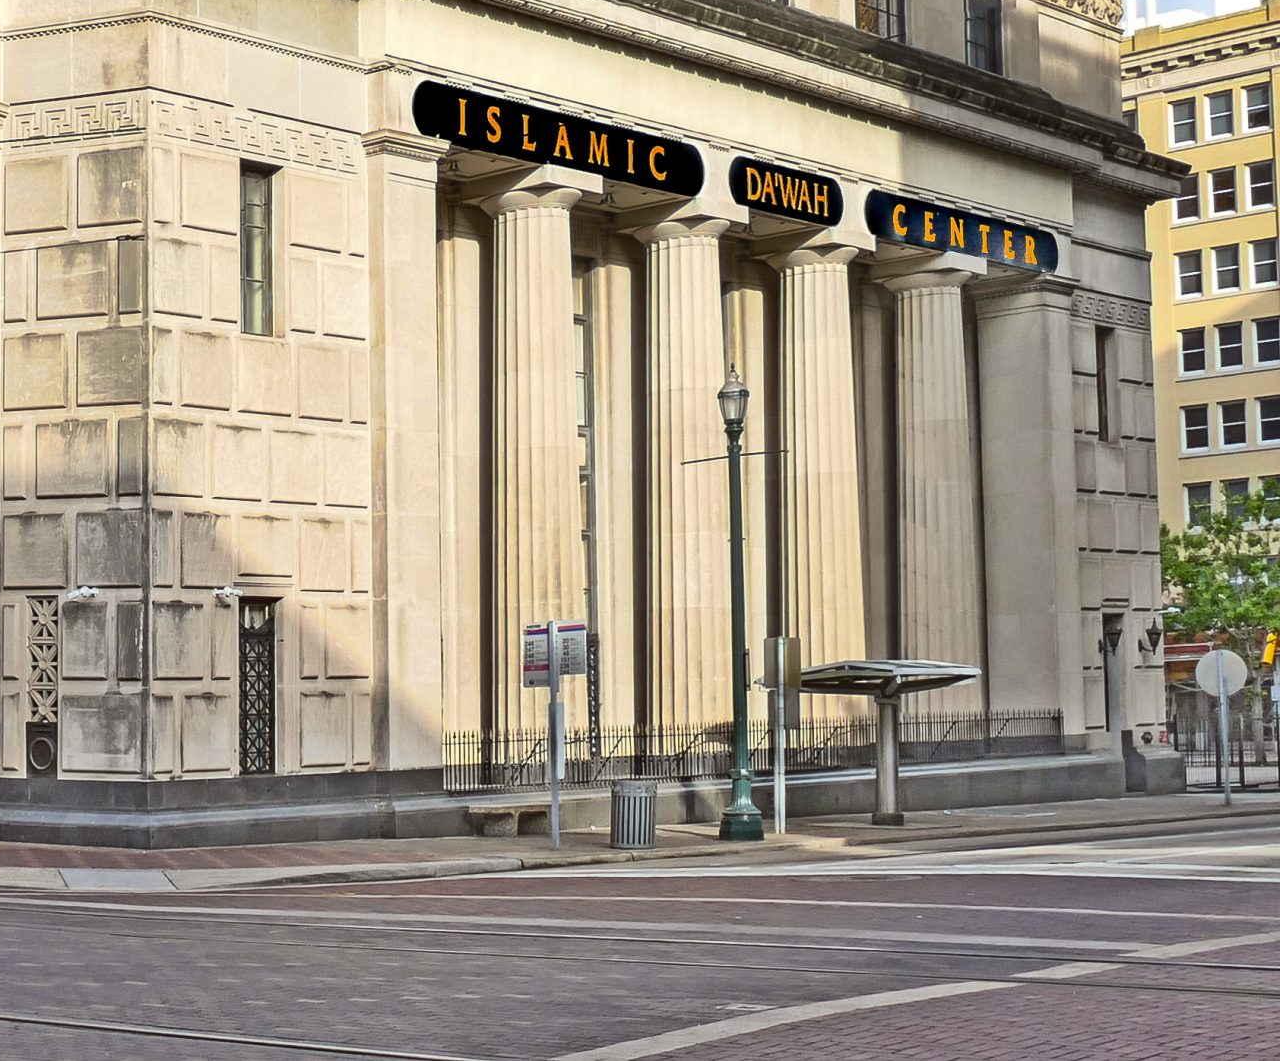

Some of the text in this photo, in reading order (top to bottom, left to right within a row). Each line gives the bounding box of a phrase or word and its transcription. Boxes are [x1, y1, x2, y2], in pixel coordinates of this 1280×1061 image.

[458, 98, 1038, 265] ISLAMIC DA'WAH CENTER
